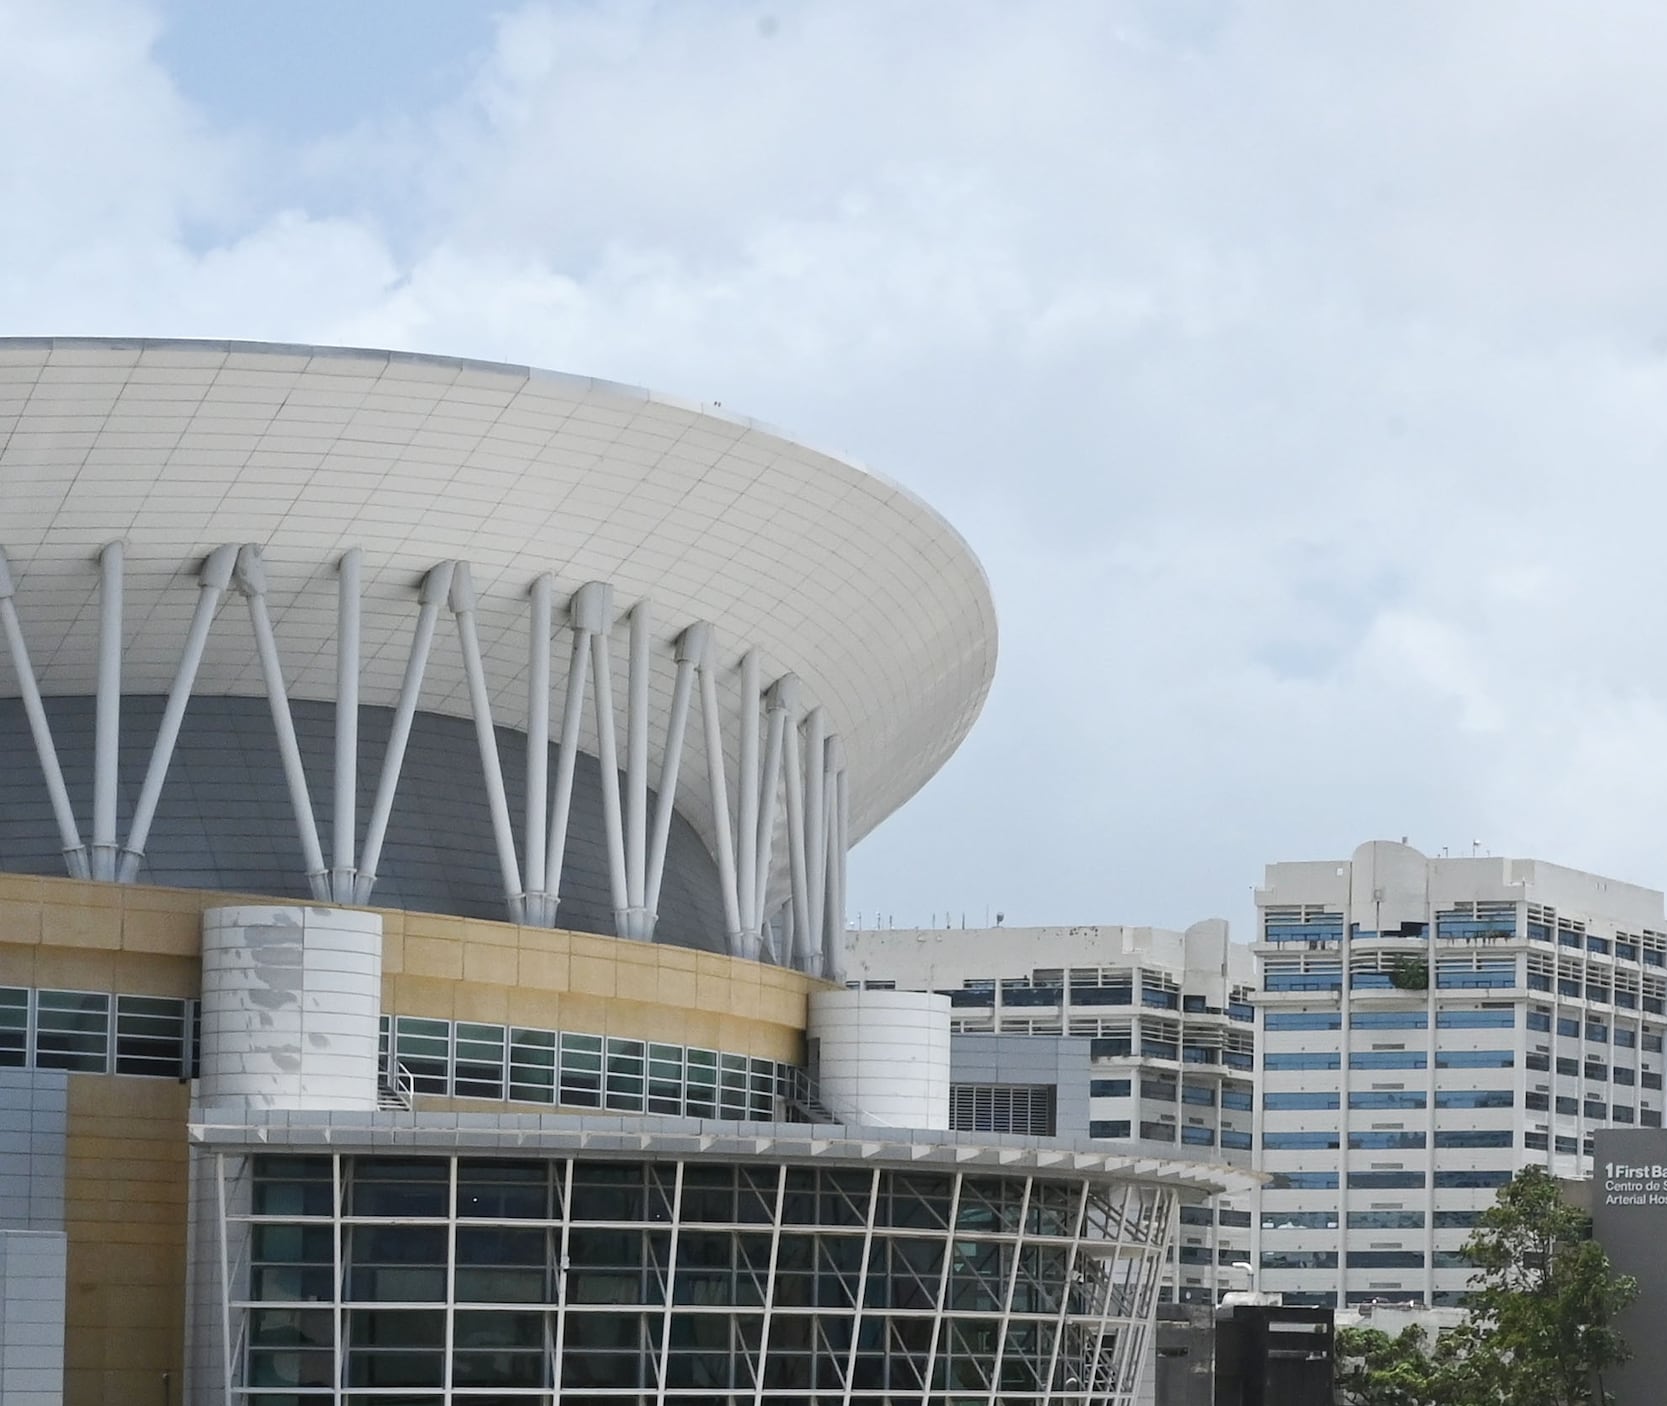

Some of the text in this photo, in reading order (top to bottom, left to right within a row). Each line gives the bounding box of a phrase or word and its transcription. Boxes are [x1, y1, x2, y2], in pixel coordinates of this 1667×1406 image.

[1605, 1180, 1642, 1192] Centro
[1645, 1181, 1660, 1191] de
[1605, 1194, 1646, 1205] Arterial
